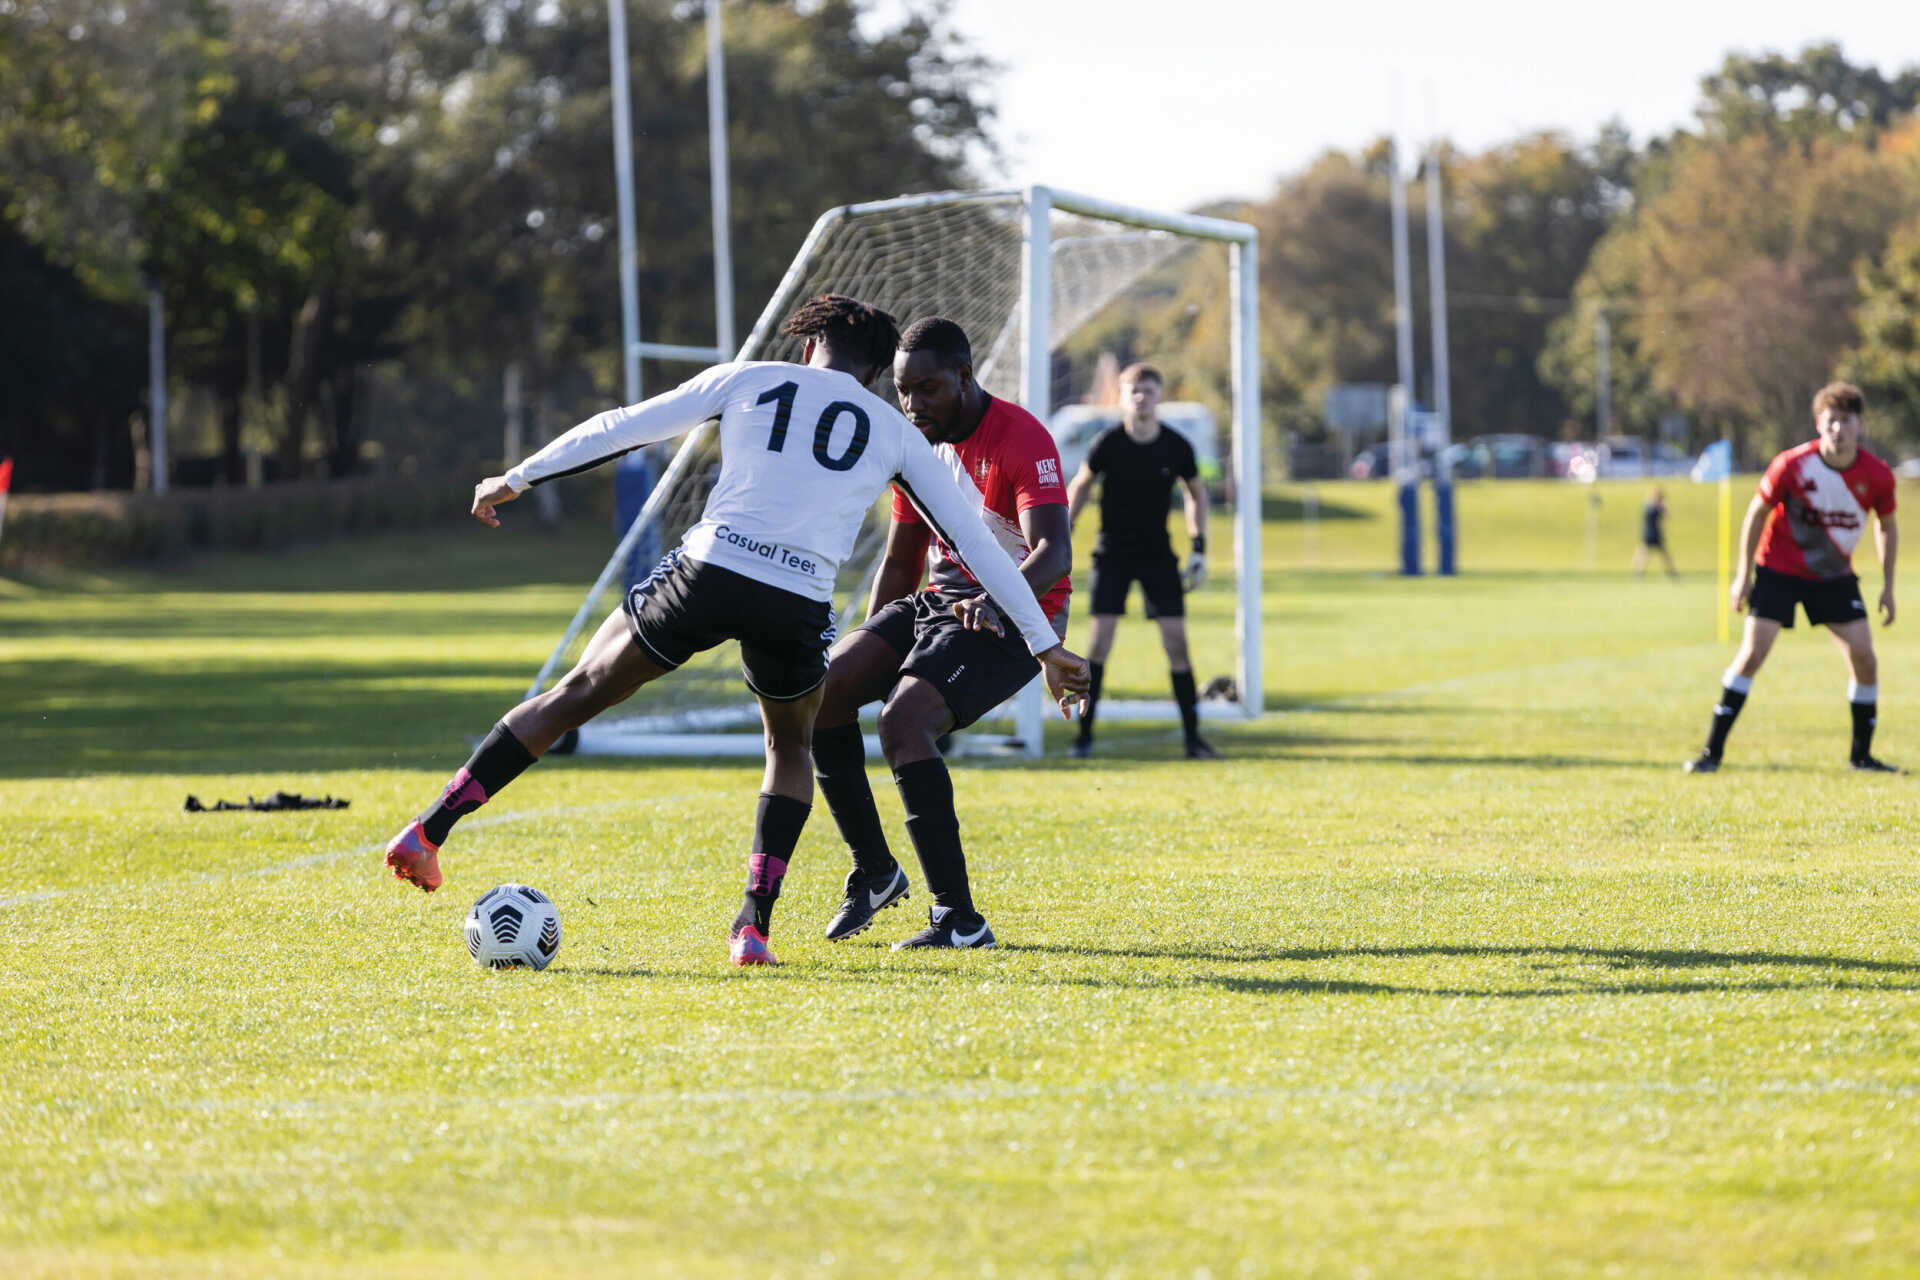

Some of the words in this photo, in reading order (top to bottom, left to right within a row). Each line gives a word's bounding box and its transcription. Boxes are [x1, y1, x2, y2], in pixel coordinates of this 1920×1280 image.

[756, 381, 870, 471] 10
[1036, 458, 1056, 474] KENT
[1039, 472, 1059, 483] UNION
[715, 525, 777, 559] Casual
[781, 549, 816, 575] Tees
